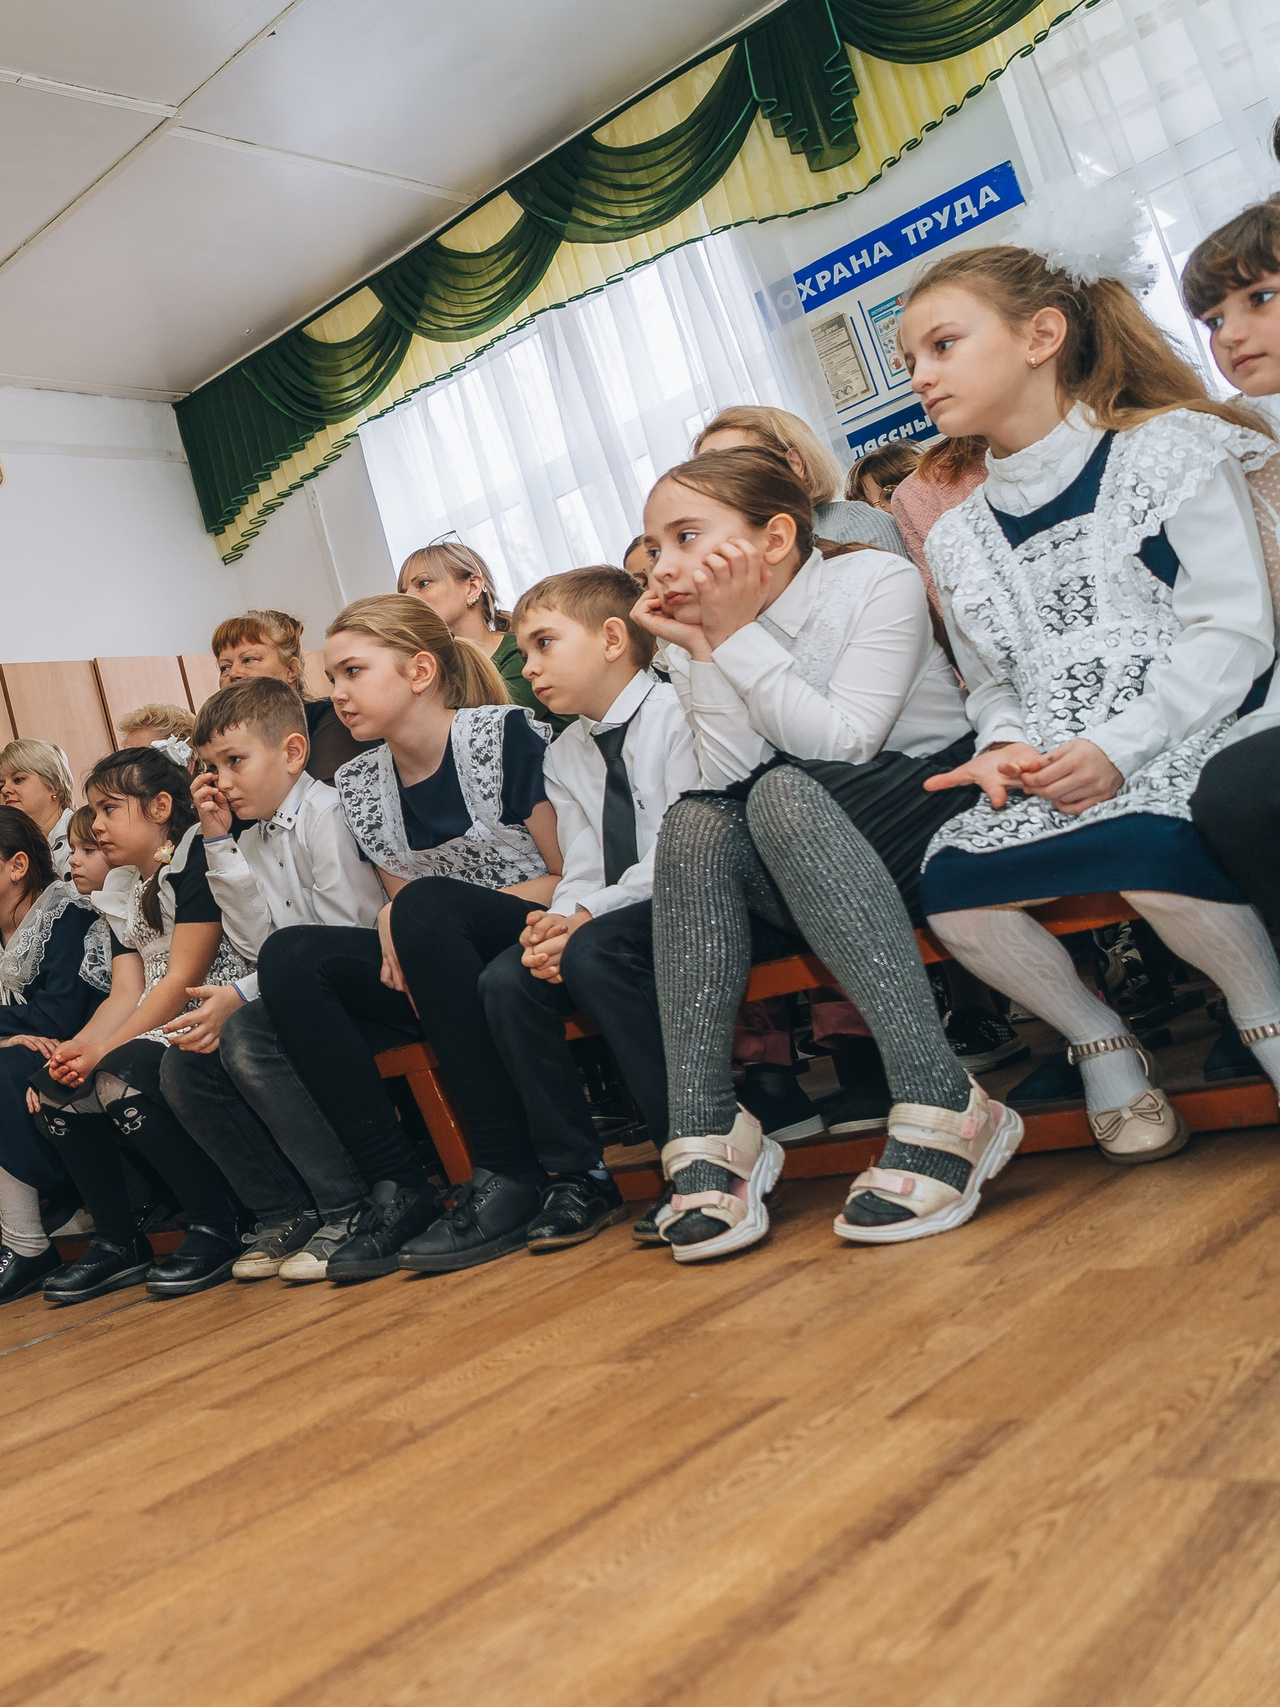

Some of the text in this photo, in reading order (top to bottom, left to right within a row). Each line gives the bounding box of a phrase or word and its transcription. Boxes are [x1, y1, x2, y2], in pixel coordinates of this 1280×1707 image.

[777, 184, 1001, 310] ОХРАНА ТРУДА
[849, 415, 933, 461] лассны
